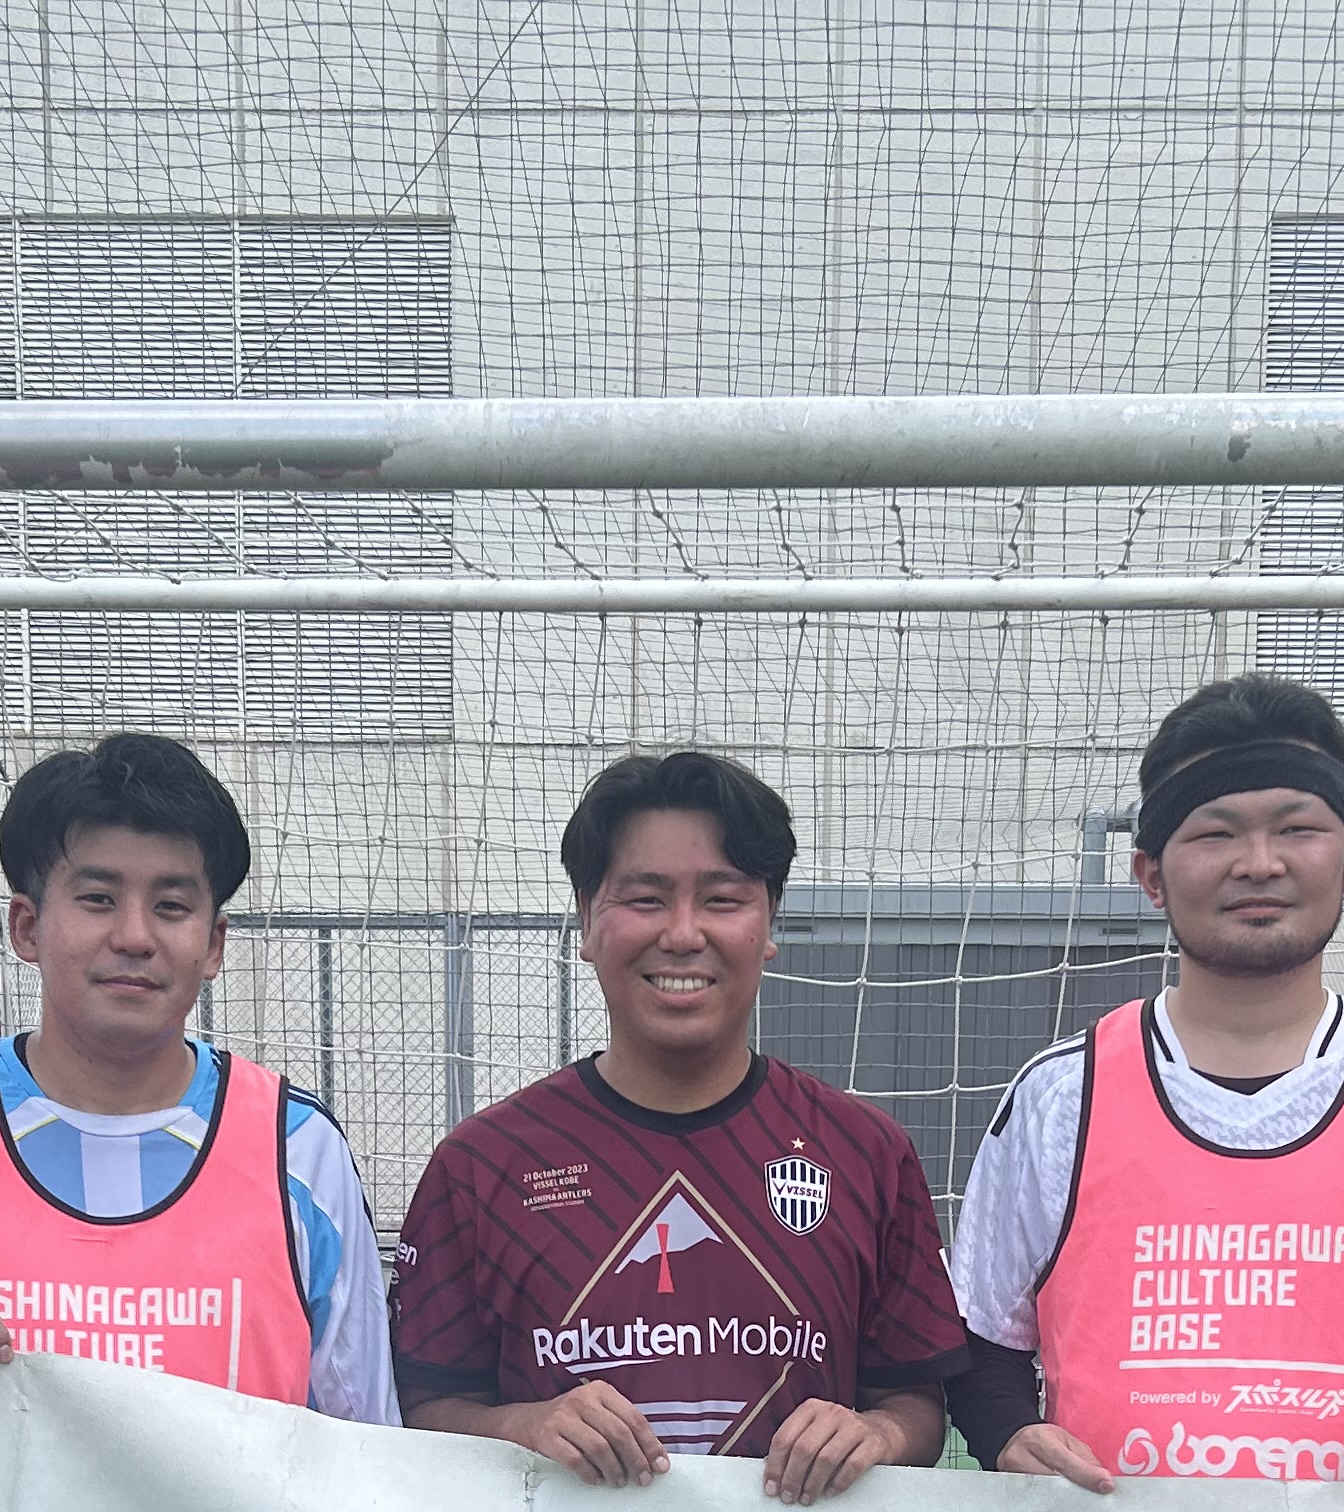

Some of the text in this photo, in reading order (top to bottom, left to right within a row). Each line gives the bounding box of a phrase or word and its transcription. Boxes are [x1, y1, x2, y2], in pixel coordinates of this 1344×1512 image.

[522, 1164, 589, 1183] 21 October 2023
[787, 1184, 824, 1200] VISSEL
[1131, 1268, 1298, 1308] CULTURE
[532, 1315, 827, 1367] Rakuten Mobile
[1129, 1312, 1223, 1353] BASE
[1129, 1390, 1222, 1408] Powered by
